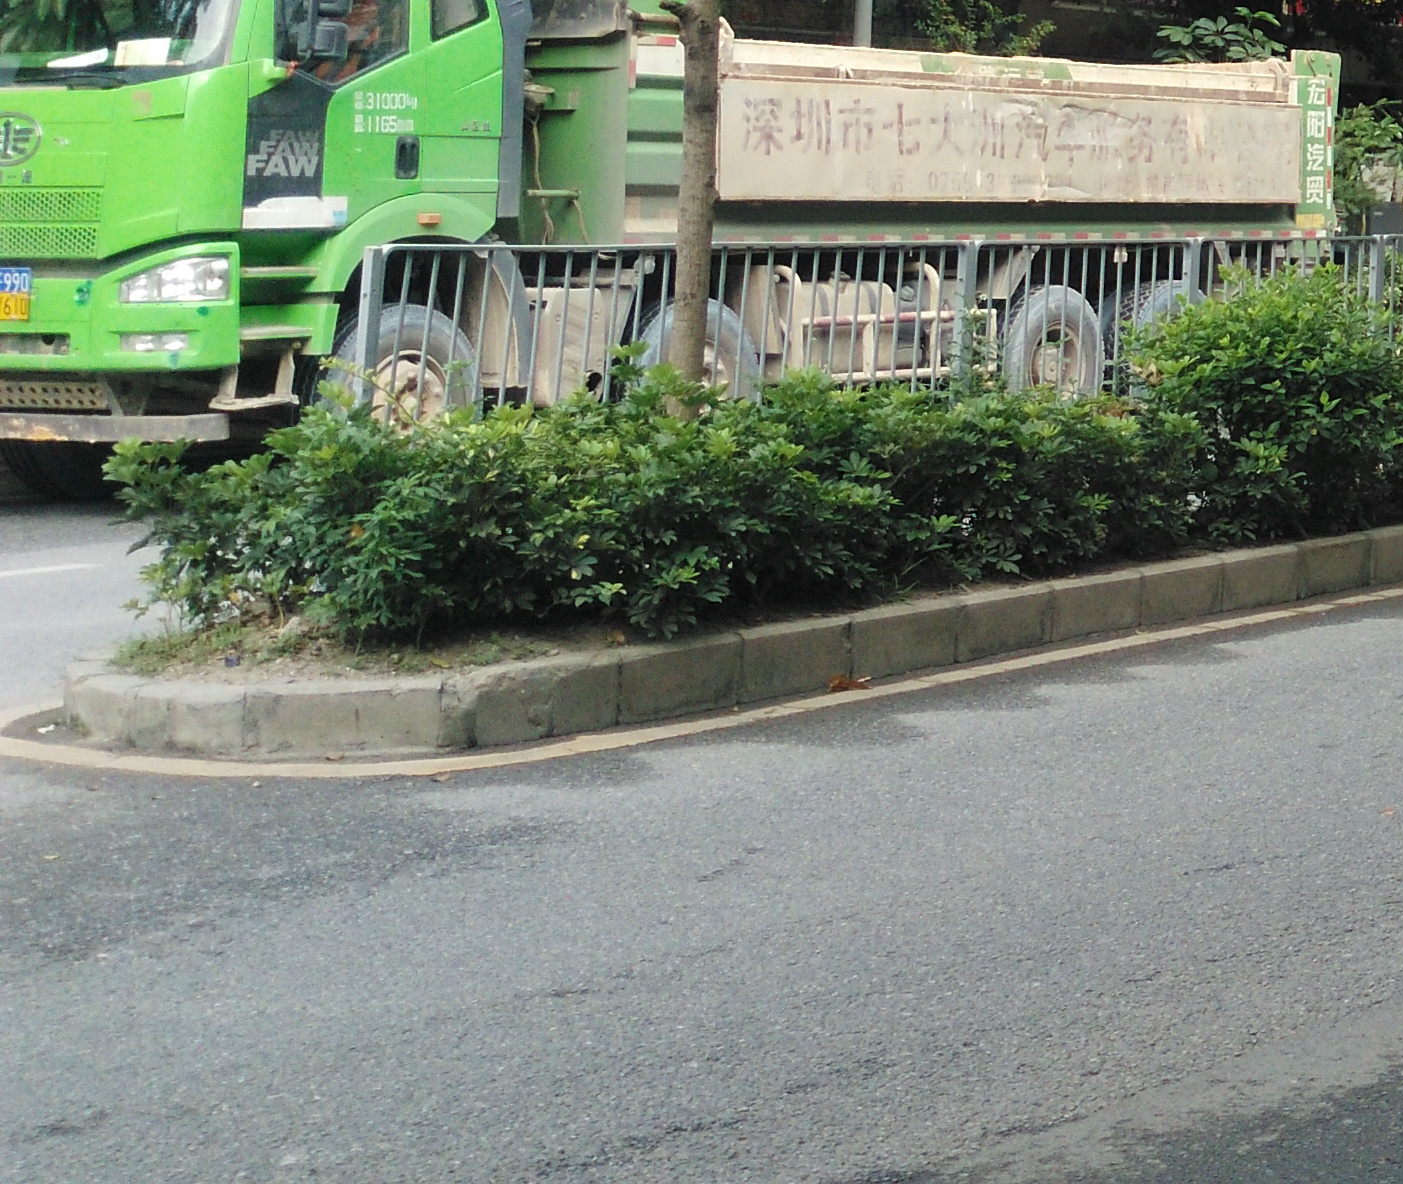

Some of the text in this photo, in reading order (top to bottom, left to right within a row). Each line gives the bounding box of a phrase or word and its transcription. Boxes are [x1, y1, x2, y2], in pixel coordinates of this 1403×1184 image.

[269, 129, 320, 143] FAW
[742, 97, 1294, 165] 深圳市七大洲汽车服务有
[1306, 79, 1326, 204] 宏阳汽贸
[259, 140, 320, 156] FAW
[246, 154, 319, 177] FAW
